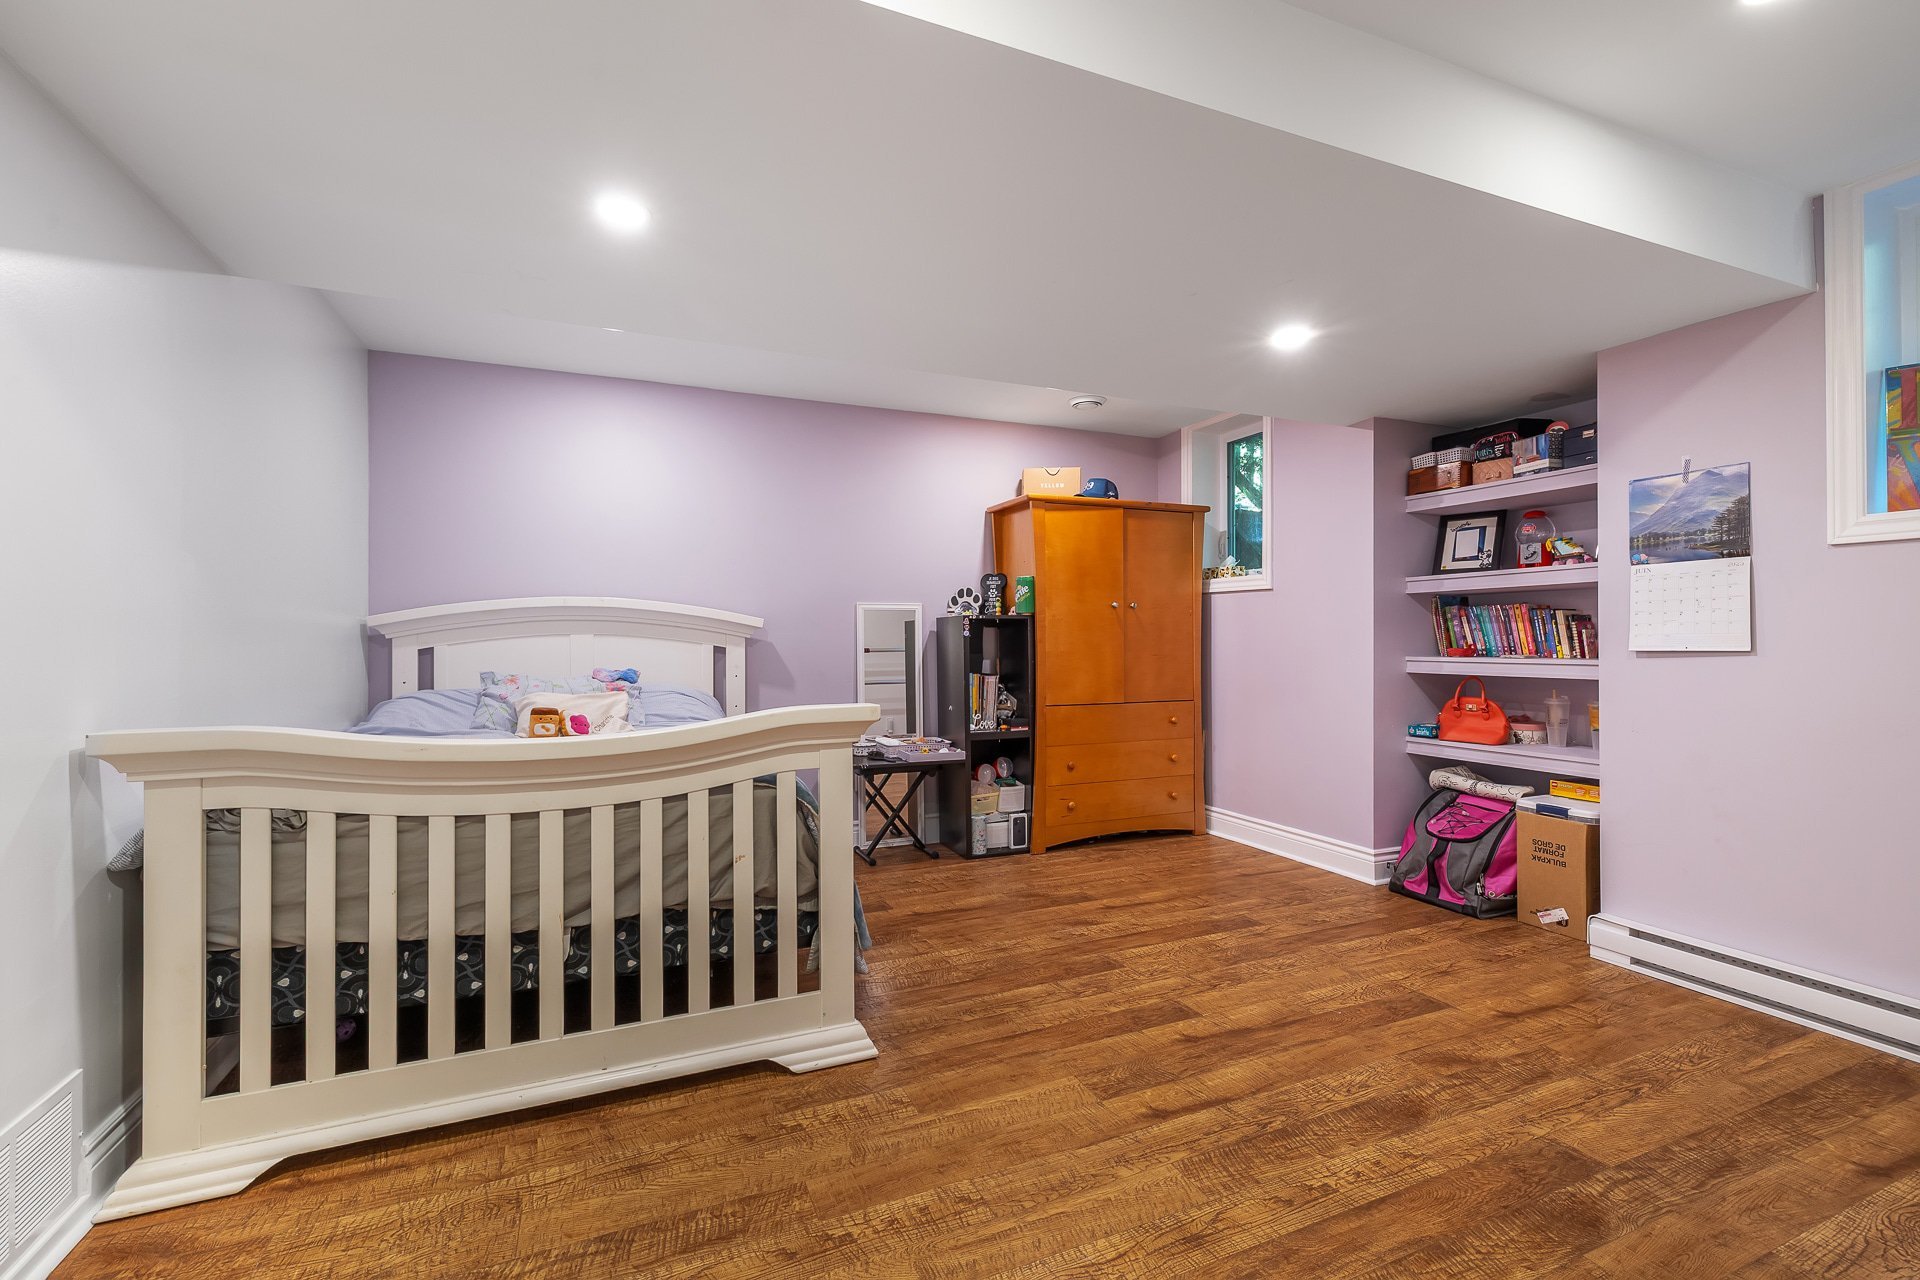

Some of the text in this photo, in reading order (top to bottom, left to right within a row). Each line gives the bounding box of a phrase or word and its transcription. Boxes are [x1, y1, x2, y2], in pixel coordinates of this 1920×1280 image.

[1633, 567, 1653, 575] JUIN
[972, 713, 997, 730] Love
[1531, 838, 1566, 852] DE GROS
[1532, 845, 1565, 858] FORMAT
[1530, 853, 1567, 868] BULKPAK
